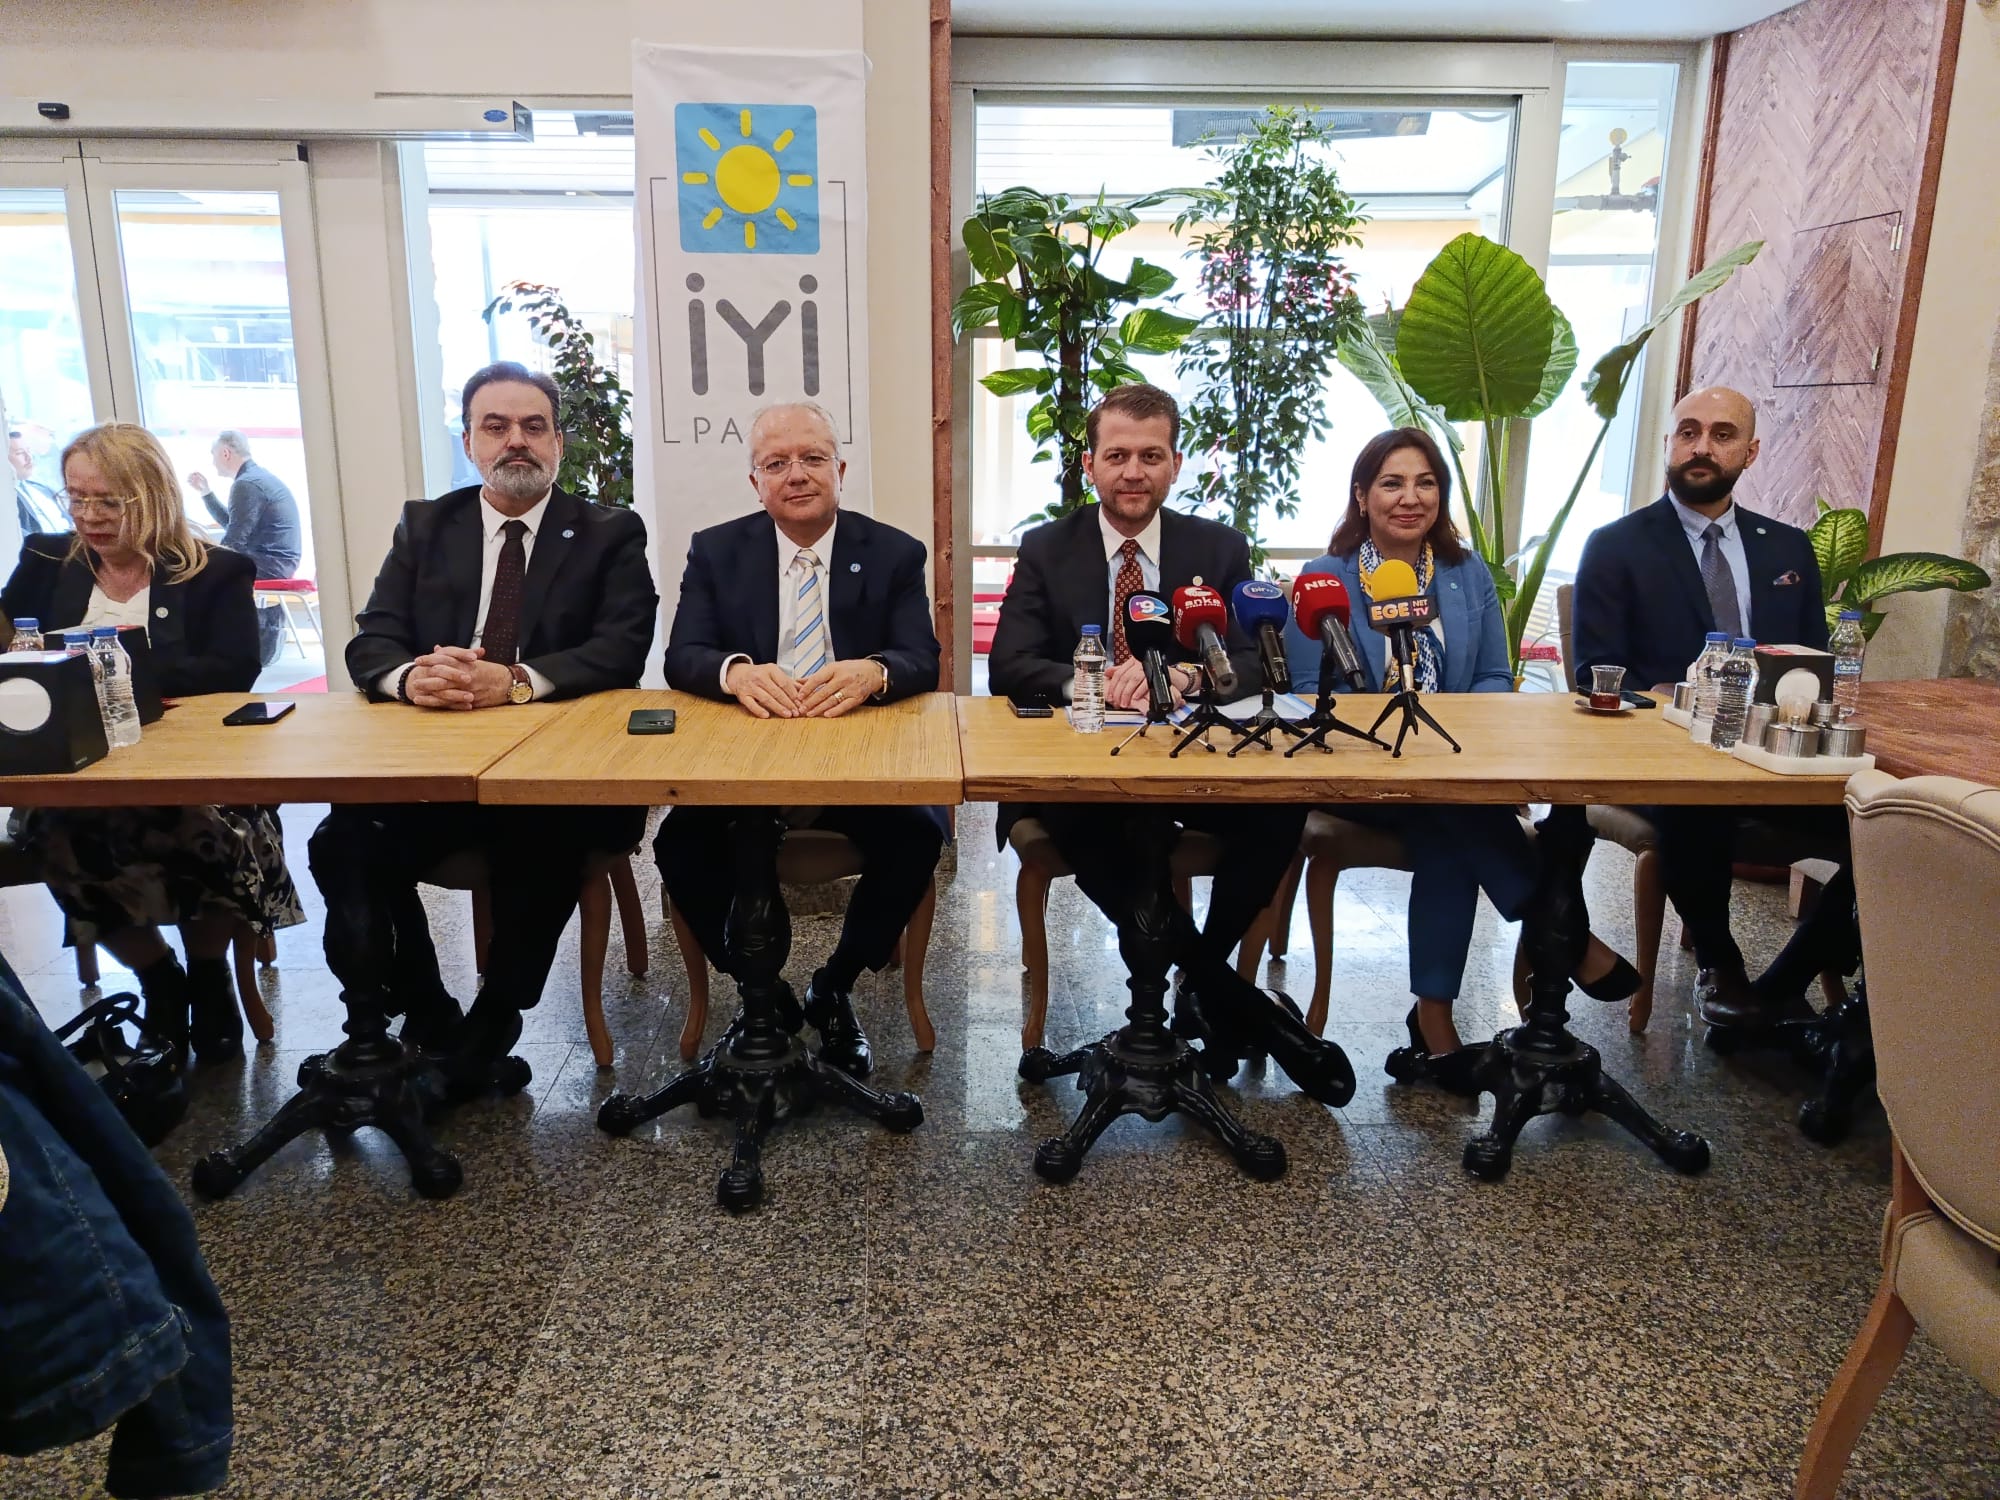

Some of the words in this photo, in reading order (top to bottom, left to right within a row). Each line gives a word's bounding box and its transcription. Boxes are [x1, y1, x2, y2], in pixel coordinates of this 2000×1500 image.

[1304, 579, 1341, 591] NEO
[1412, 599, 1428, 607] NET
[1371, 602, 1410, 621] EGE
[1413, 606, 1429, 616] TV
